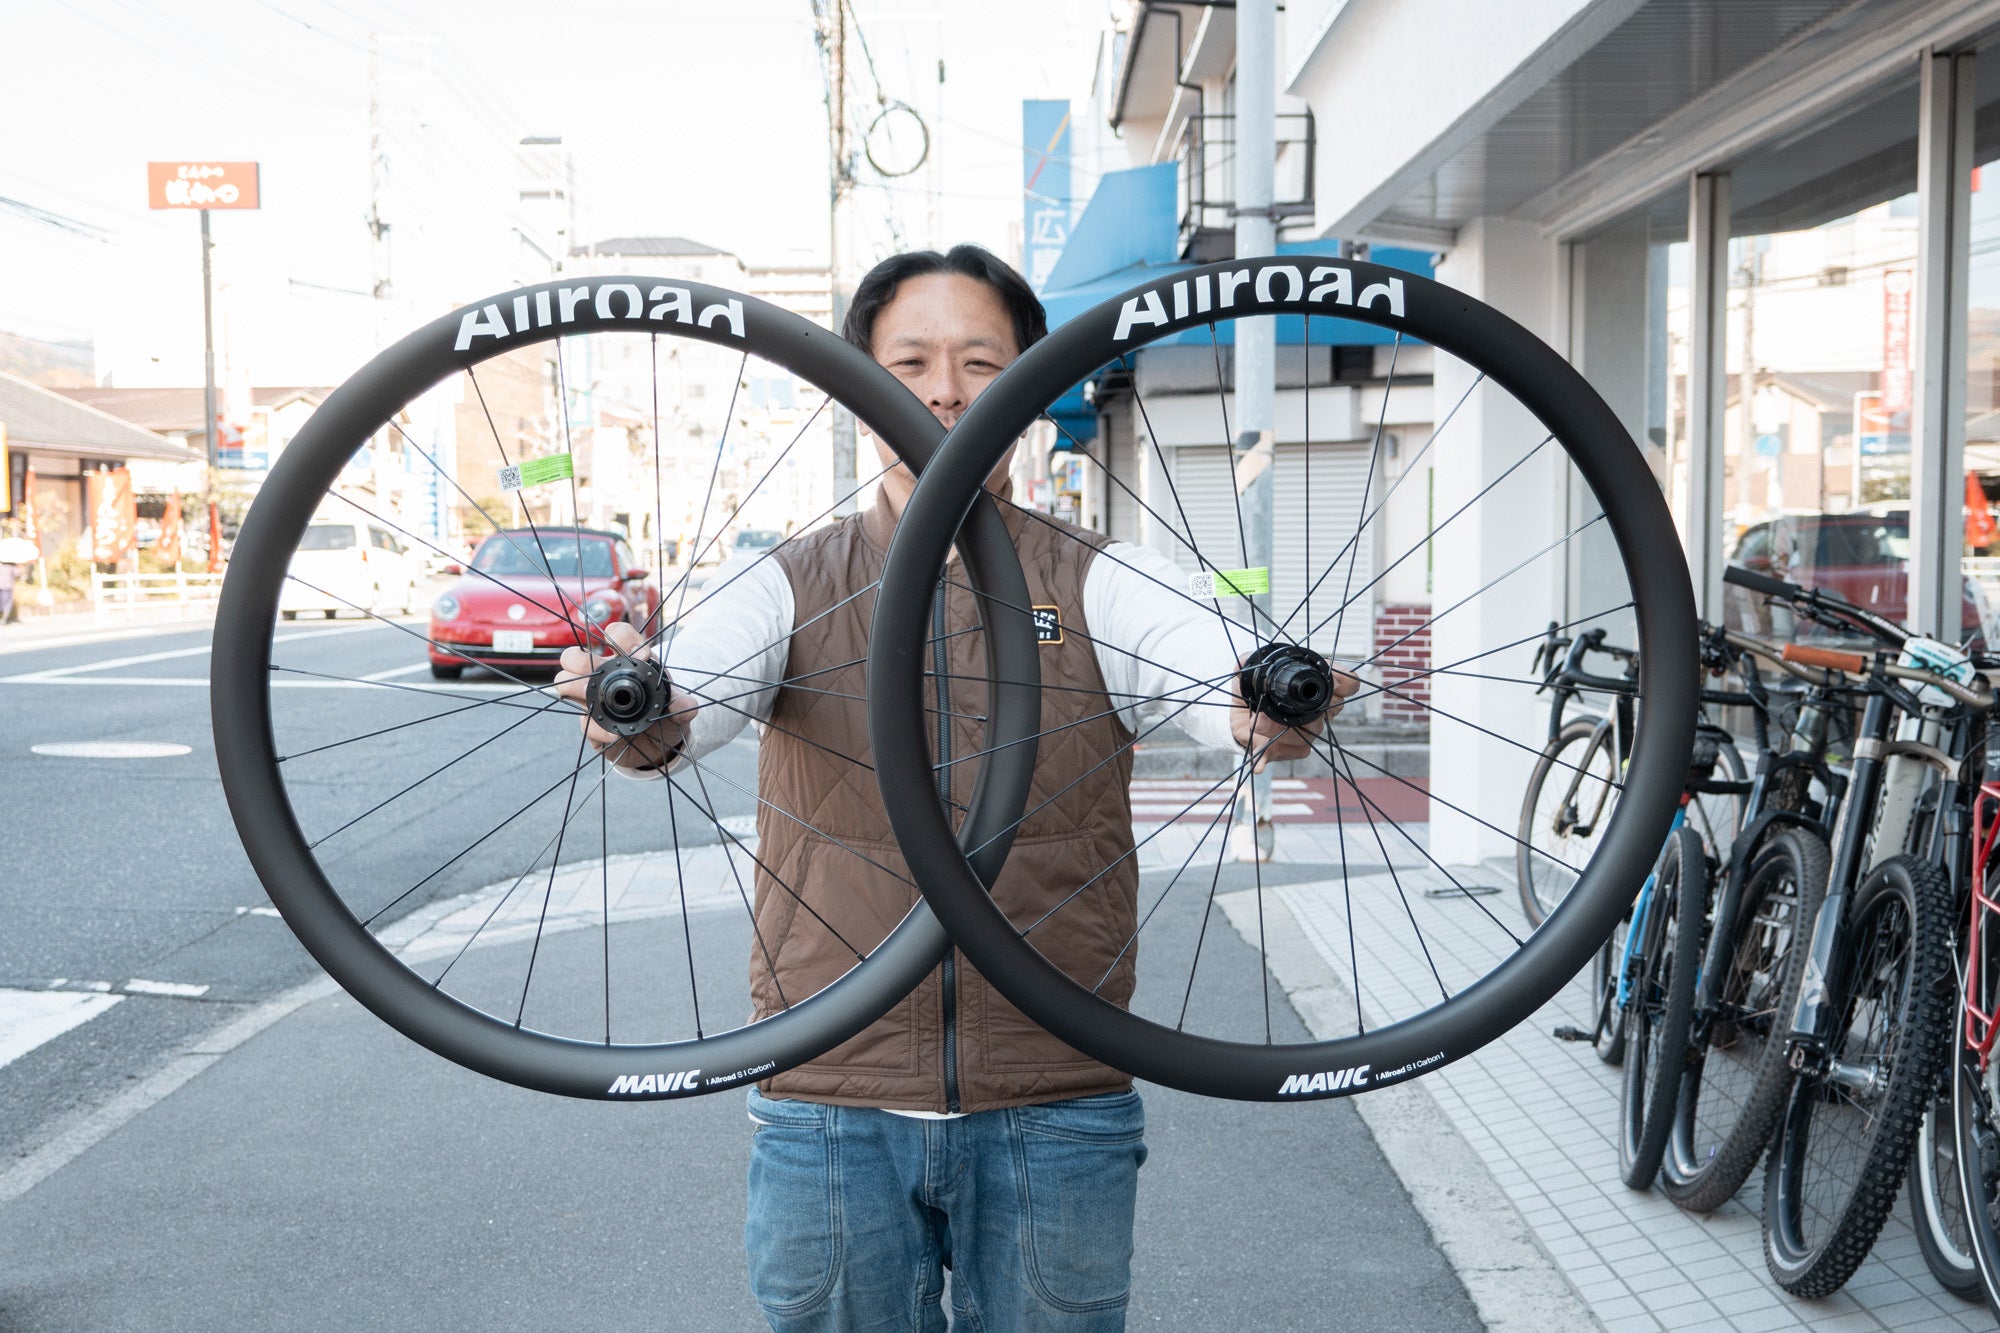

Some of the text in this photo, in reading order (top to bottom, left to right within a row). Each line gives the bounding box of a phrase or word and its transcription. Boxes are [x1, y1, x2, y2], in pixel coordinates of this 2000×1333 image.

[1113, 265, 1405, 341] Allroad
[454, 284, 746, 351] Allroad
[710, 1073, 737, 1085] Allroad
[747, 1063, 772, 1075] Carbon
[1278, 1064, 1371, 1094] MAVIC
[1380, 1066, 1406, 1080] Allroad
[1416, 1054, 1441, 1068] Carbon
[608, 1069, 701, 1094] MAVIC
